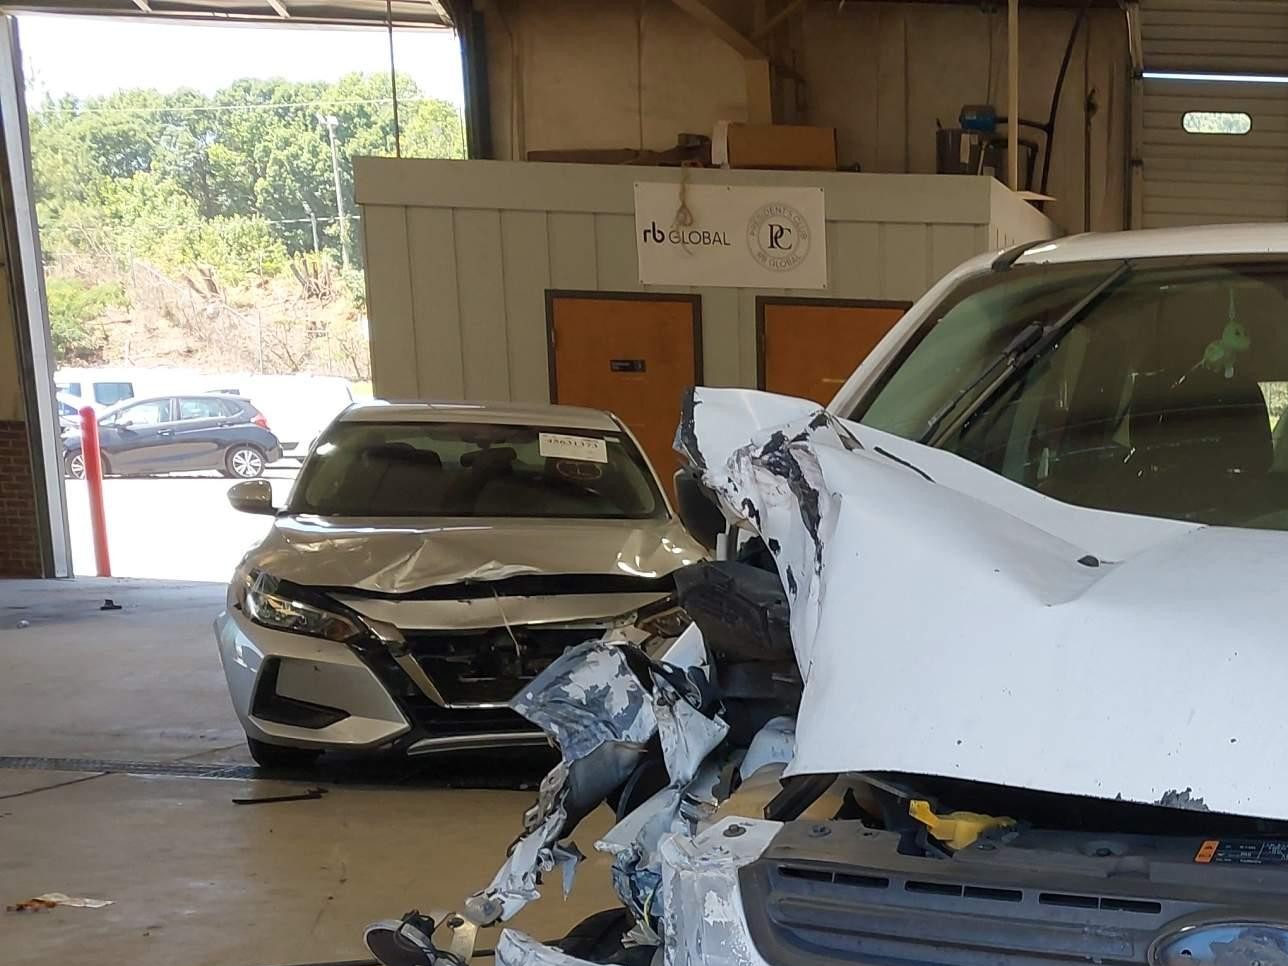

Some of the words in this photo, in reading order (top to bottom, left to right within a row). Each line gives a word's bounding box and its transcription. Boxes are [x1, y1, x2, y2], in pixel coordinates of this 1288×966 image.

[643, 221, 665, 244] rb
[668, 230, 731, 246] GLOBAL
[768, 223, 793, 250] PC
